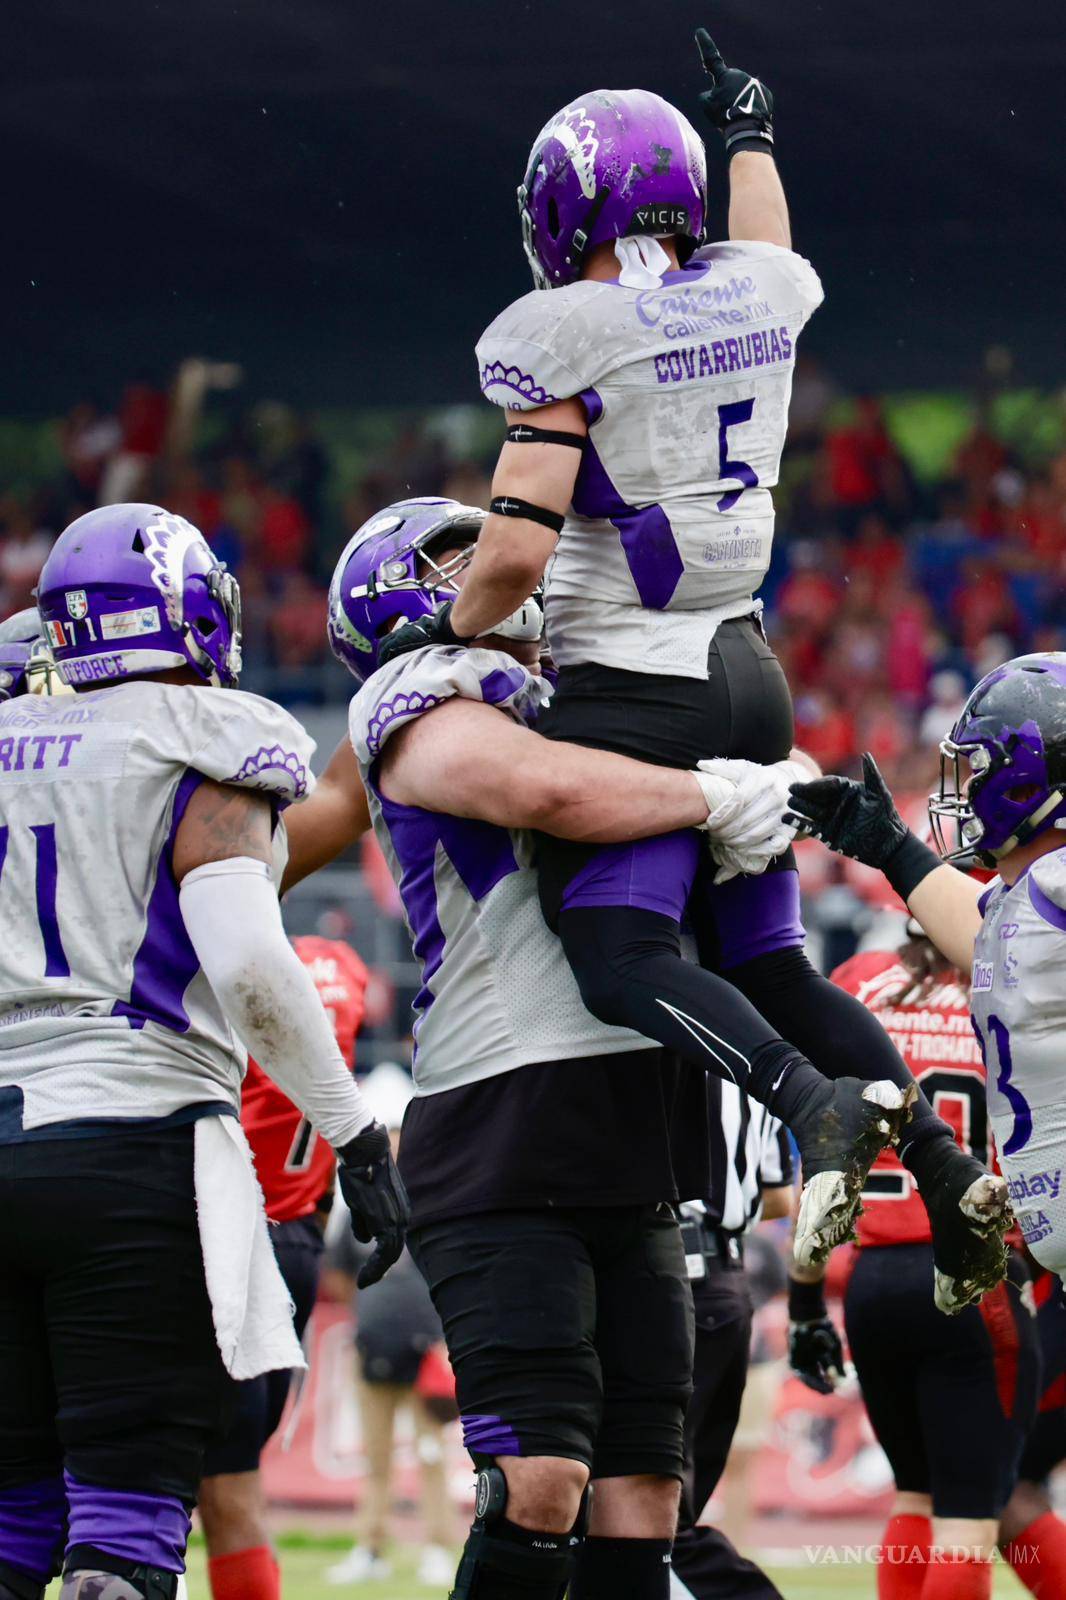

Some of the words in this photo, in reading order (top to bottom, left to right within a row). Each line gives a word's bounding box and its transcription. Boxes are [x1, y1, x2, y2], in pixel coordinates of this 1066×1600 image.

[636, 210, 687, 226] VICIS
[635, 275, 757, 327] Caliente
[663, 301, 775, 340] caliente.mx
[654, 326, 792, 383] COVARRUBIAS
[717, 397, 759, 512] 5
[0, 823, 70, 977] 1
